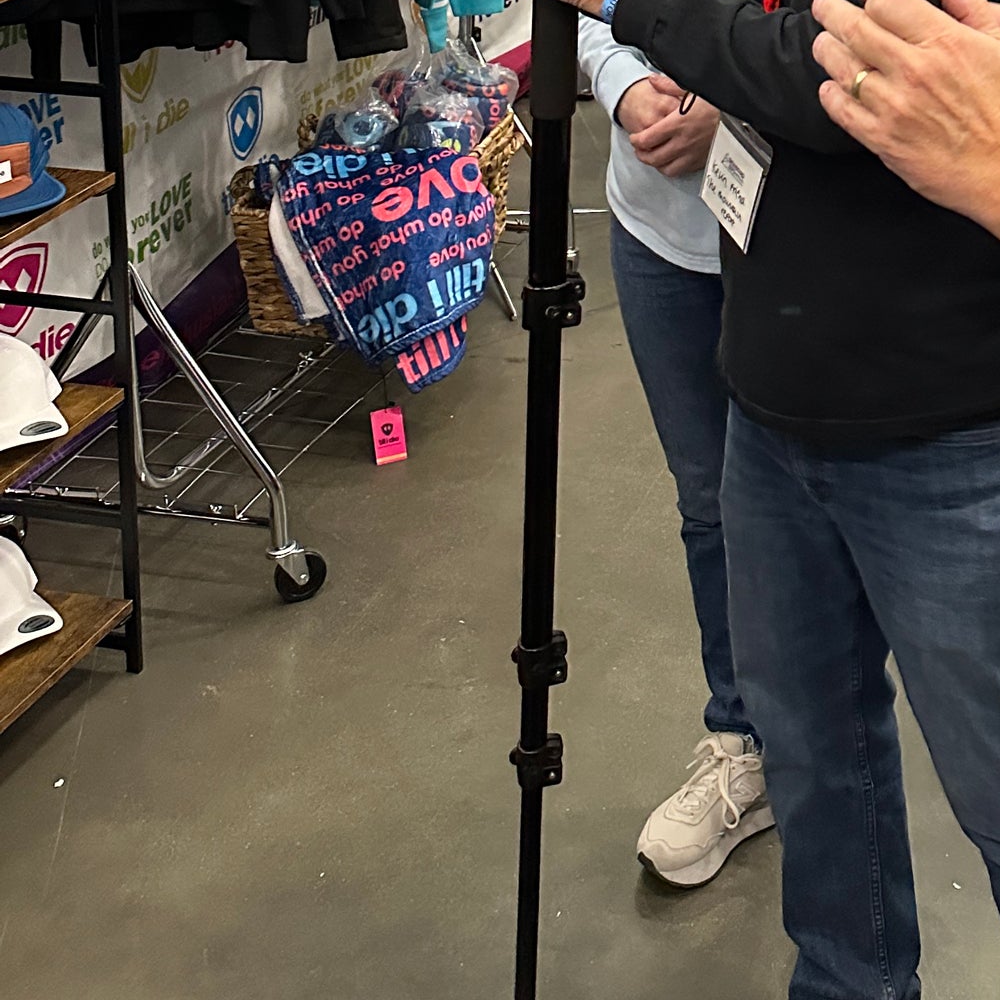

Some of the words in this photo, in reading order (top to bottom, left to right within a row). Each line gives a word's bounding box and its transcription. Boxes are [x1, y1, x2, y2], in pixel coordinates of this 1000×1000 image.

[156, 98, 190, 135] die
[293, 151, 368, 179] die
[375, 164, 403, 176] do
[380, 162, 426, 187] love
[151, 172, 193, 226] LOVE
[314, 173, 372, 195] what
[337, 192, 365, 206] do
[128, 199, 193, 266] orever
[338, 220, 365, 241] do
[428, 207, 453, 228] do
[370, 219, 425, 258] what
[331, 245, 369, 277] you
[429, 243, 466, 268] love
[380, 260, 406, 282] do
[445, 257, 486, 307] till
[427, 279, 446, 318] i
[357, 293, 418, 344] die
[397, 327, 452, 384] till
